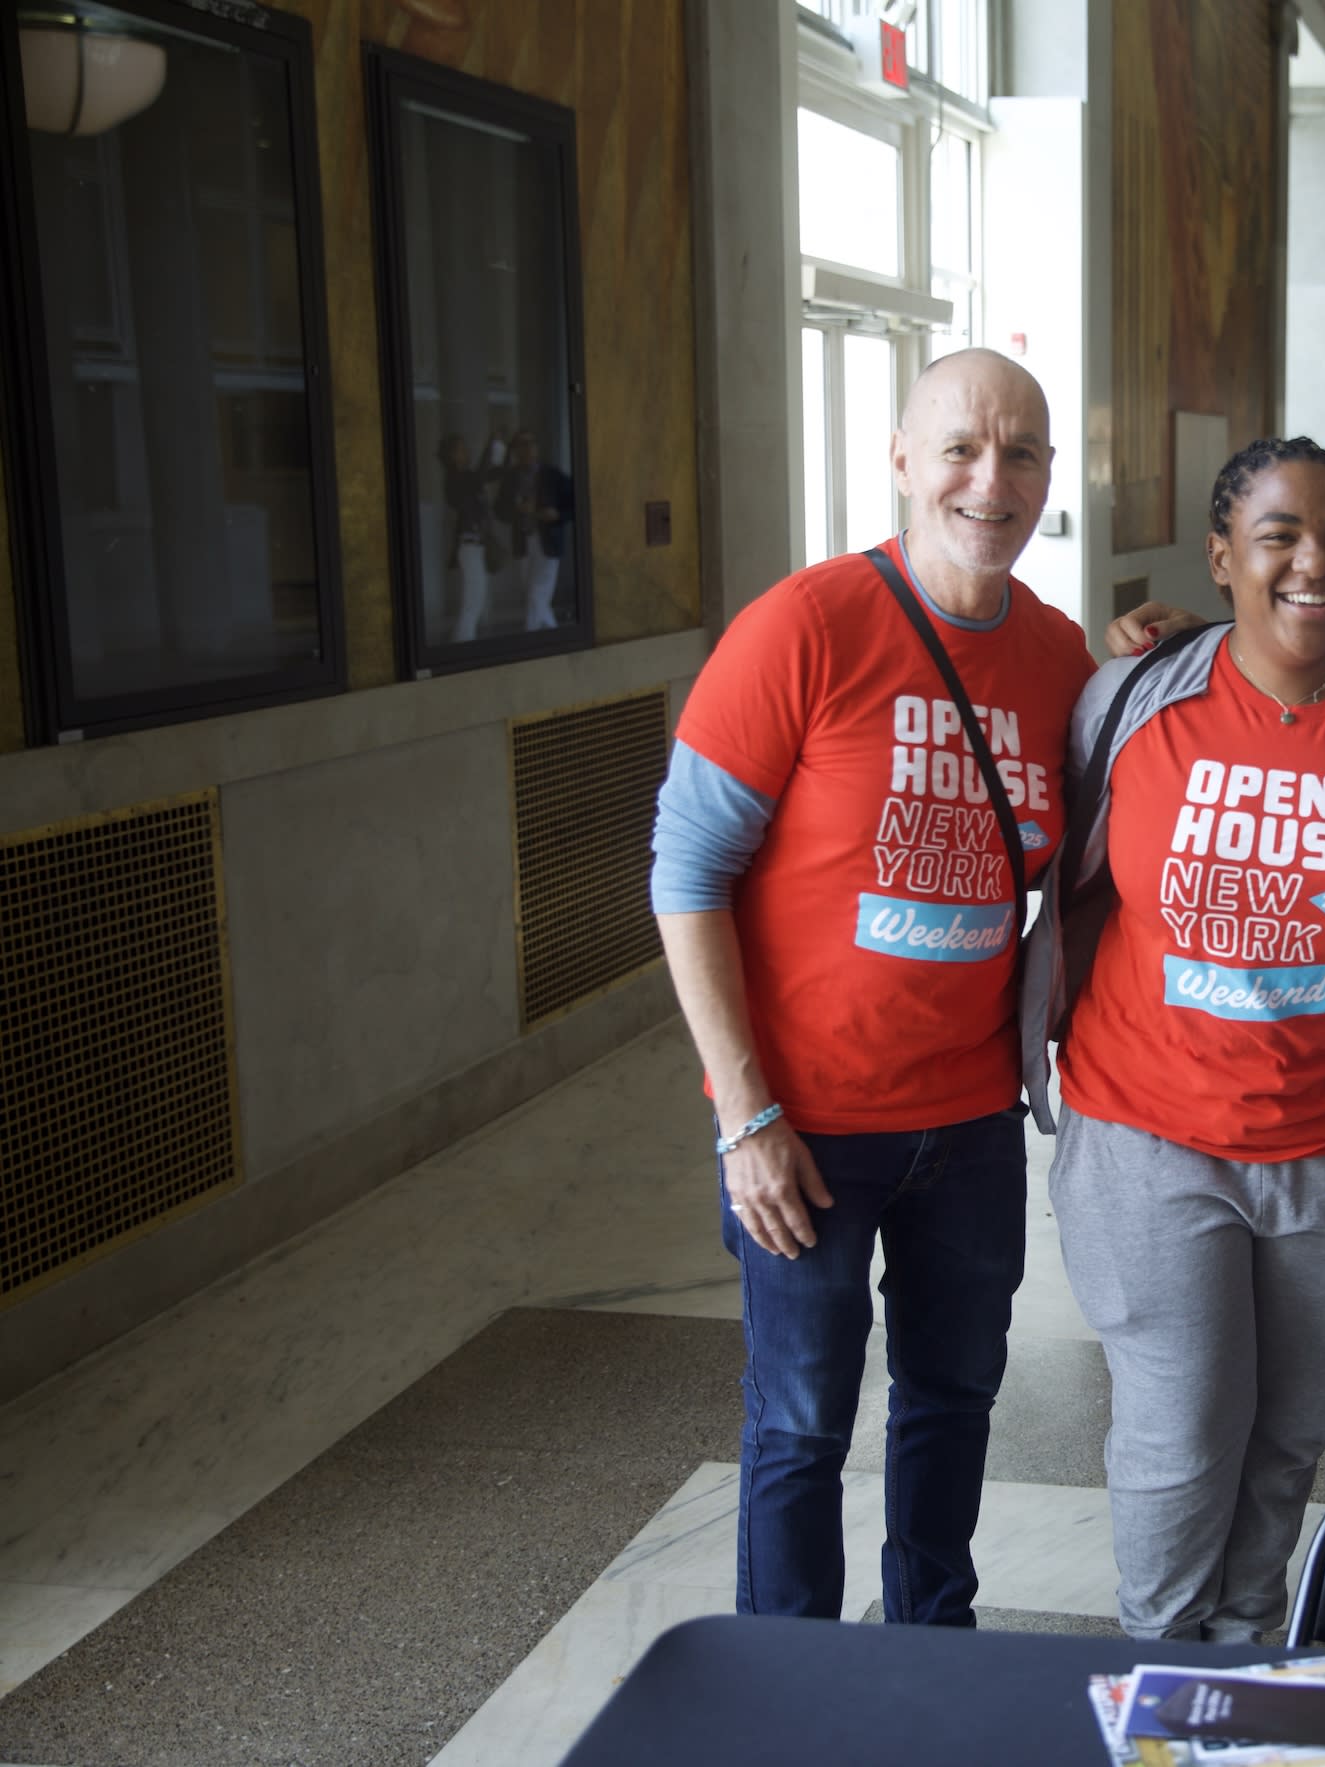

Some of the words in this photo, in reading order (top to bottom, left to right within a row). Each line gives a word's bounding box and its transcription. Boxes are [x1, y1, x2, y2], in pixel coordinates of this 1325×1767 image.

[891, 745, 1050, 811] HOUSE
[876, 797, 996, 852] NEW
[873, 845, 1005, 900] YORK
[1160, 857, 1304, 916] NEW
[870, 906, 1012, 949] Weekend
[1160, 907, 1322, 962] YORK
